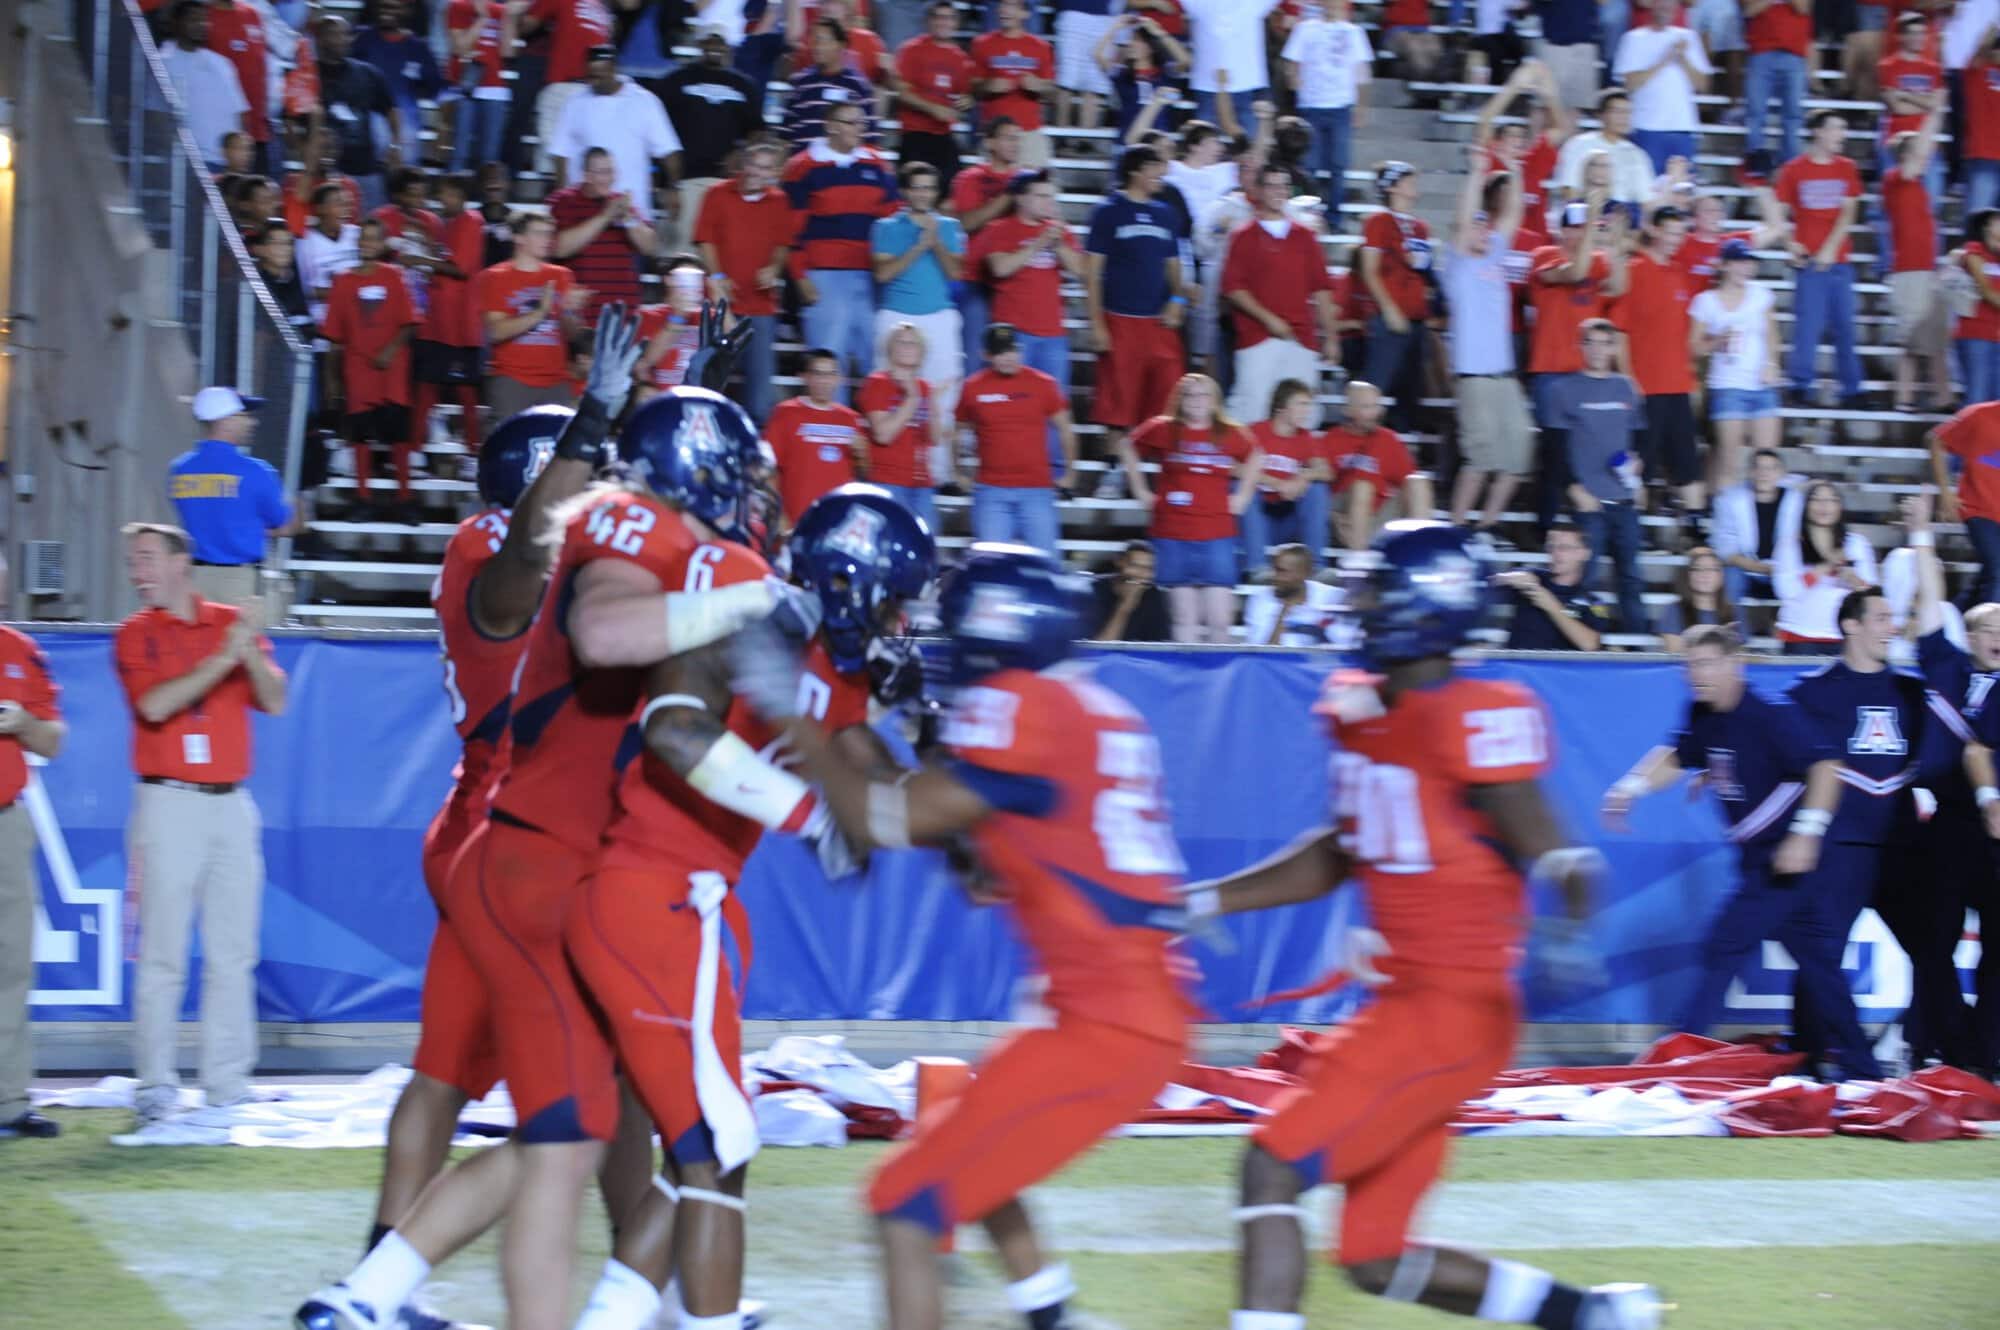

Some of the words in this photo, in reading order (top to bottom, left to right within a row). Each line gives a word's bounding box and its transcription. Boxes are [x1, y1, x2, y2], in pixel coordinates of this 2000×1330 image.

[475, 508, 513, 553] 3
[584, 500, 657, 556] 42
[1847, 705, 1908, 756] A
